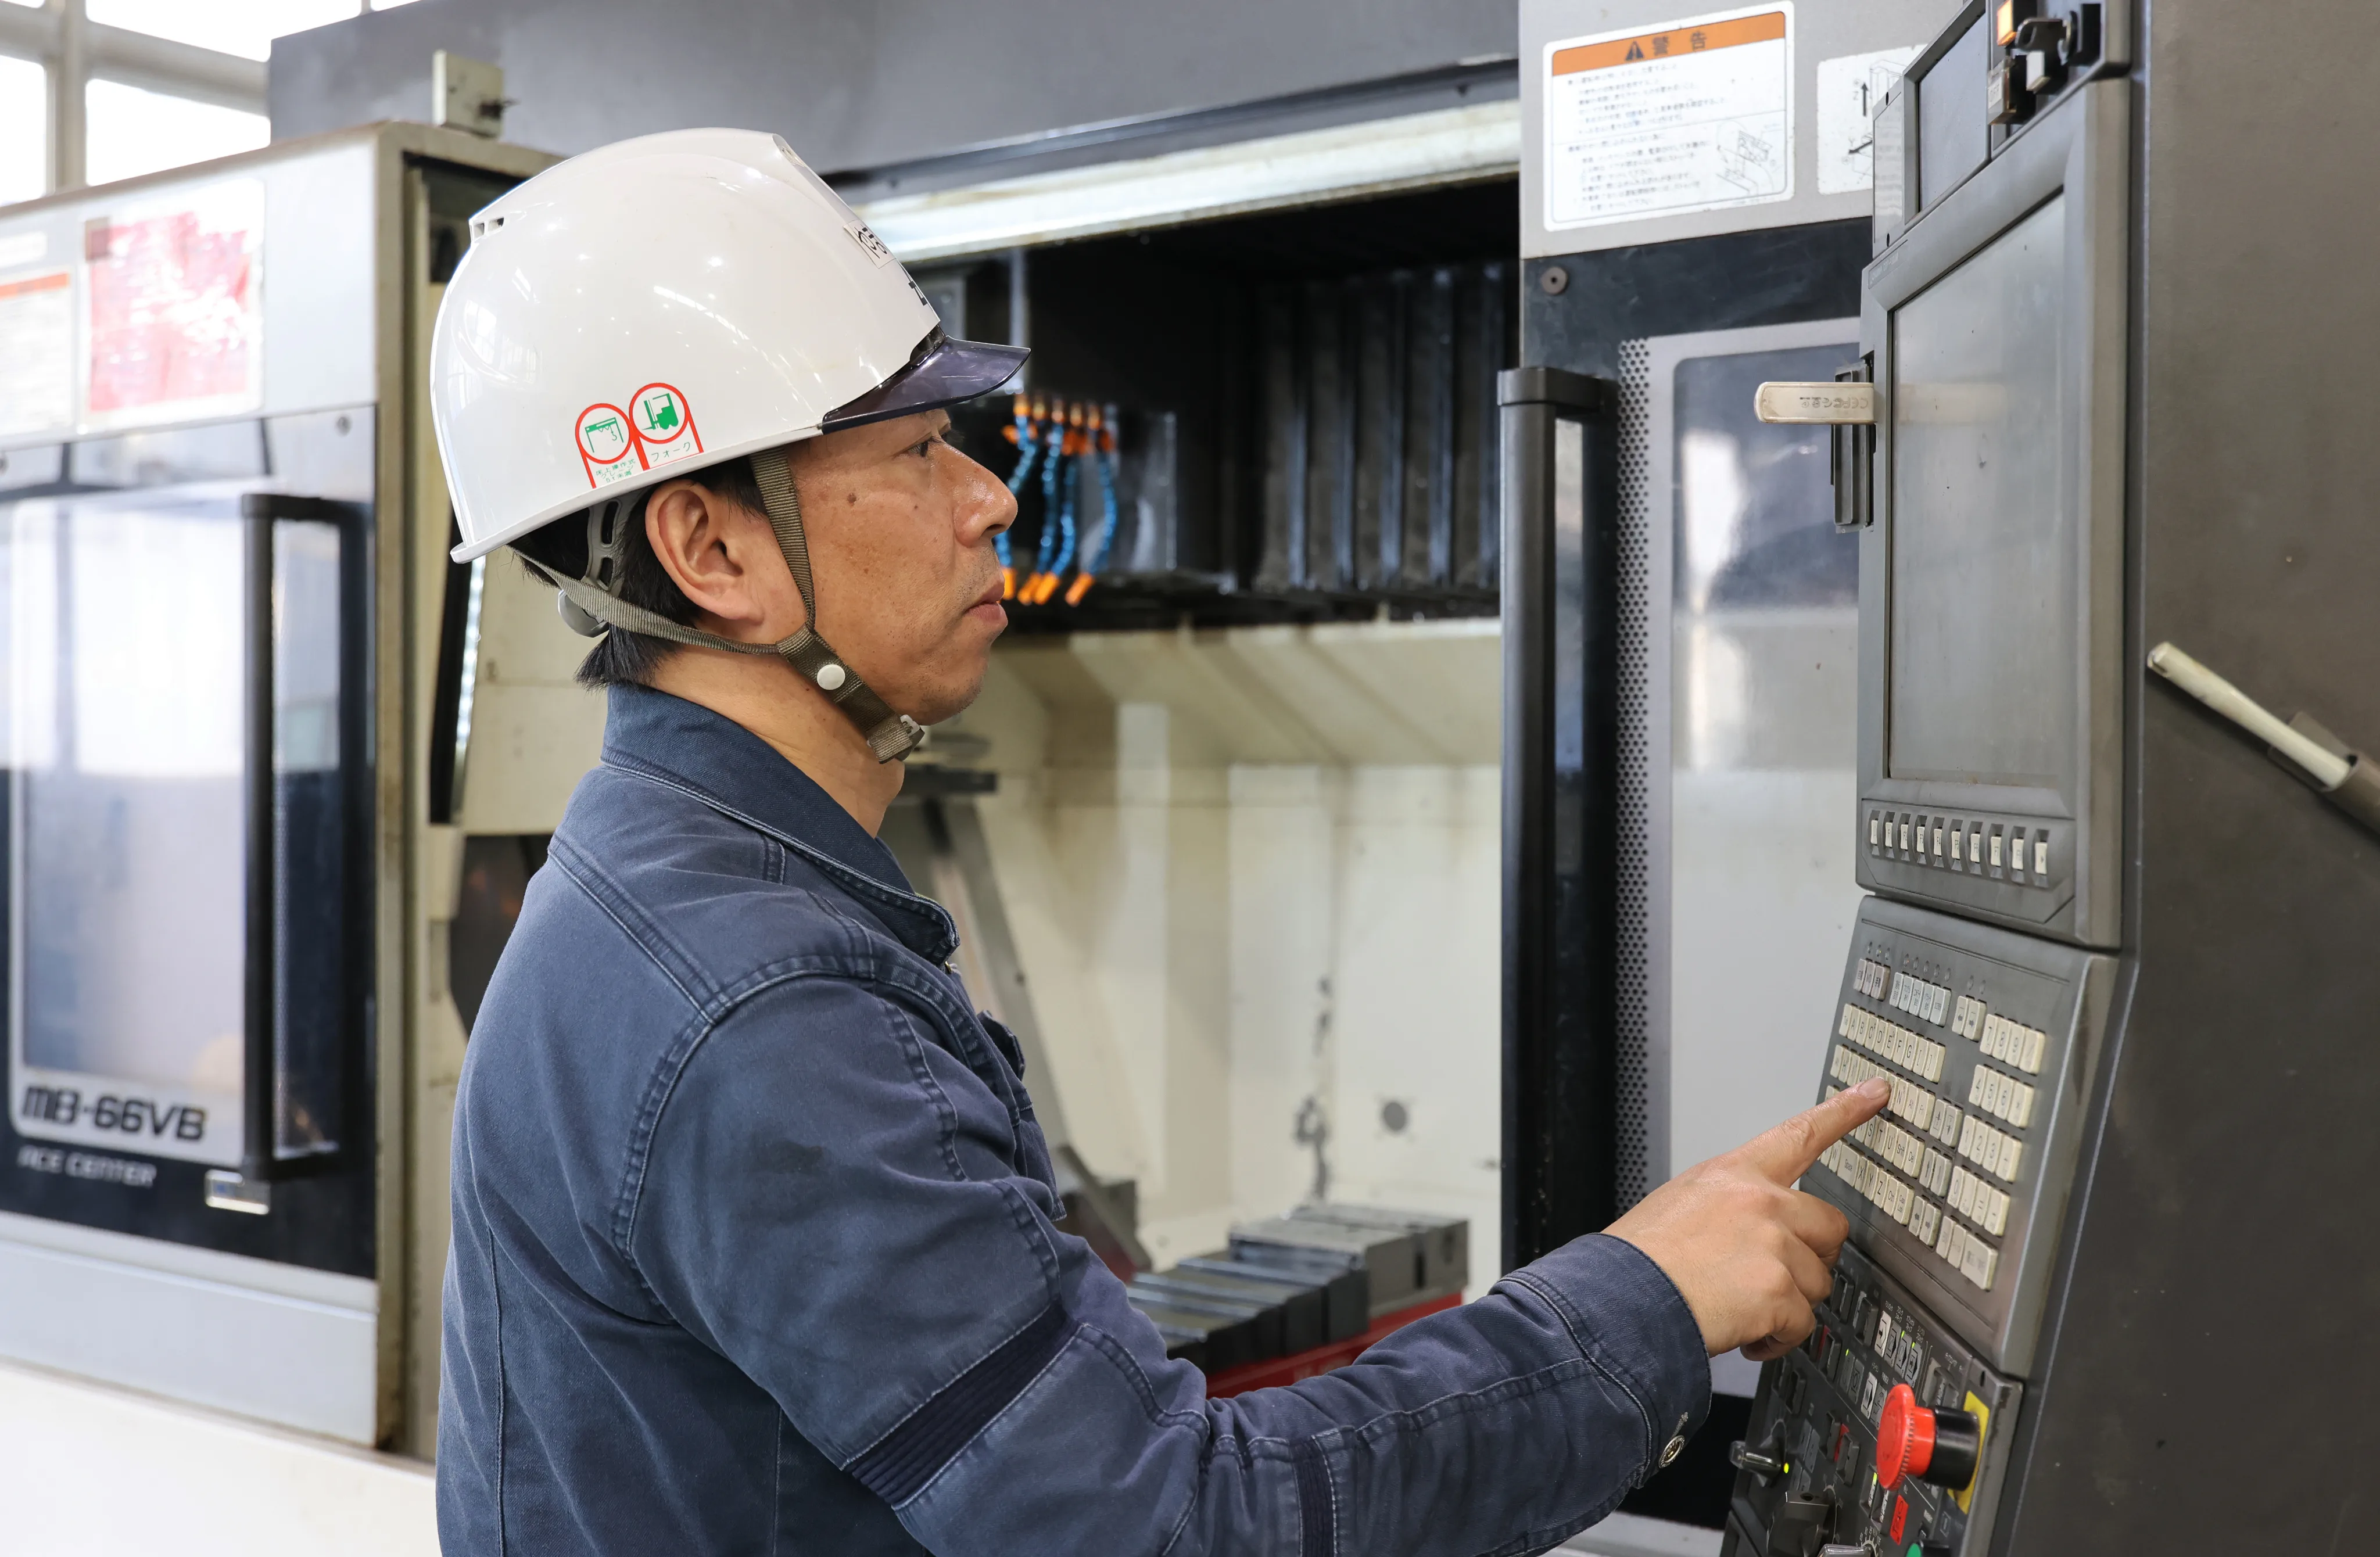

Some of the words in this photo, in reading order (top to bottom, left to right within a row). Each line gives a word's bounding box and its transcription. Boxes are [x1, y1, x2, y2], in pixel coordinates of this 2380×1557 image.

[1652, 31, 1707, 56] 警告
[651, 442, 690, 462] フォーク
[1859, 1022, 1865, 1035] B
[1868, 1026, 1873, 1039] C
[1877, 1031, 1883, 1043] D
[1887, 1035, 1892, 1049] E
[1897, 1040, 1902, 1053] F
[1906, 1045, 1912, 1058] G
[1897, 1090, 1902, 1104] N
[23, 1086, 207, 1140] MB-66VB
[1868, 1123, 1873, 1137] S
[1878, 1129, 1883, 1143] T
[1887, 1135, 1894, 1150] U
[1976, 1135, 1983, 1151] 2
[1859, 1167, 1865, 1181] X
[1868, 1173, 1874, 1187] Y
[1877, 1181, 1883, 1195] Z
